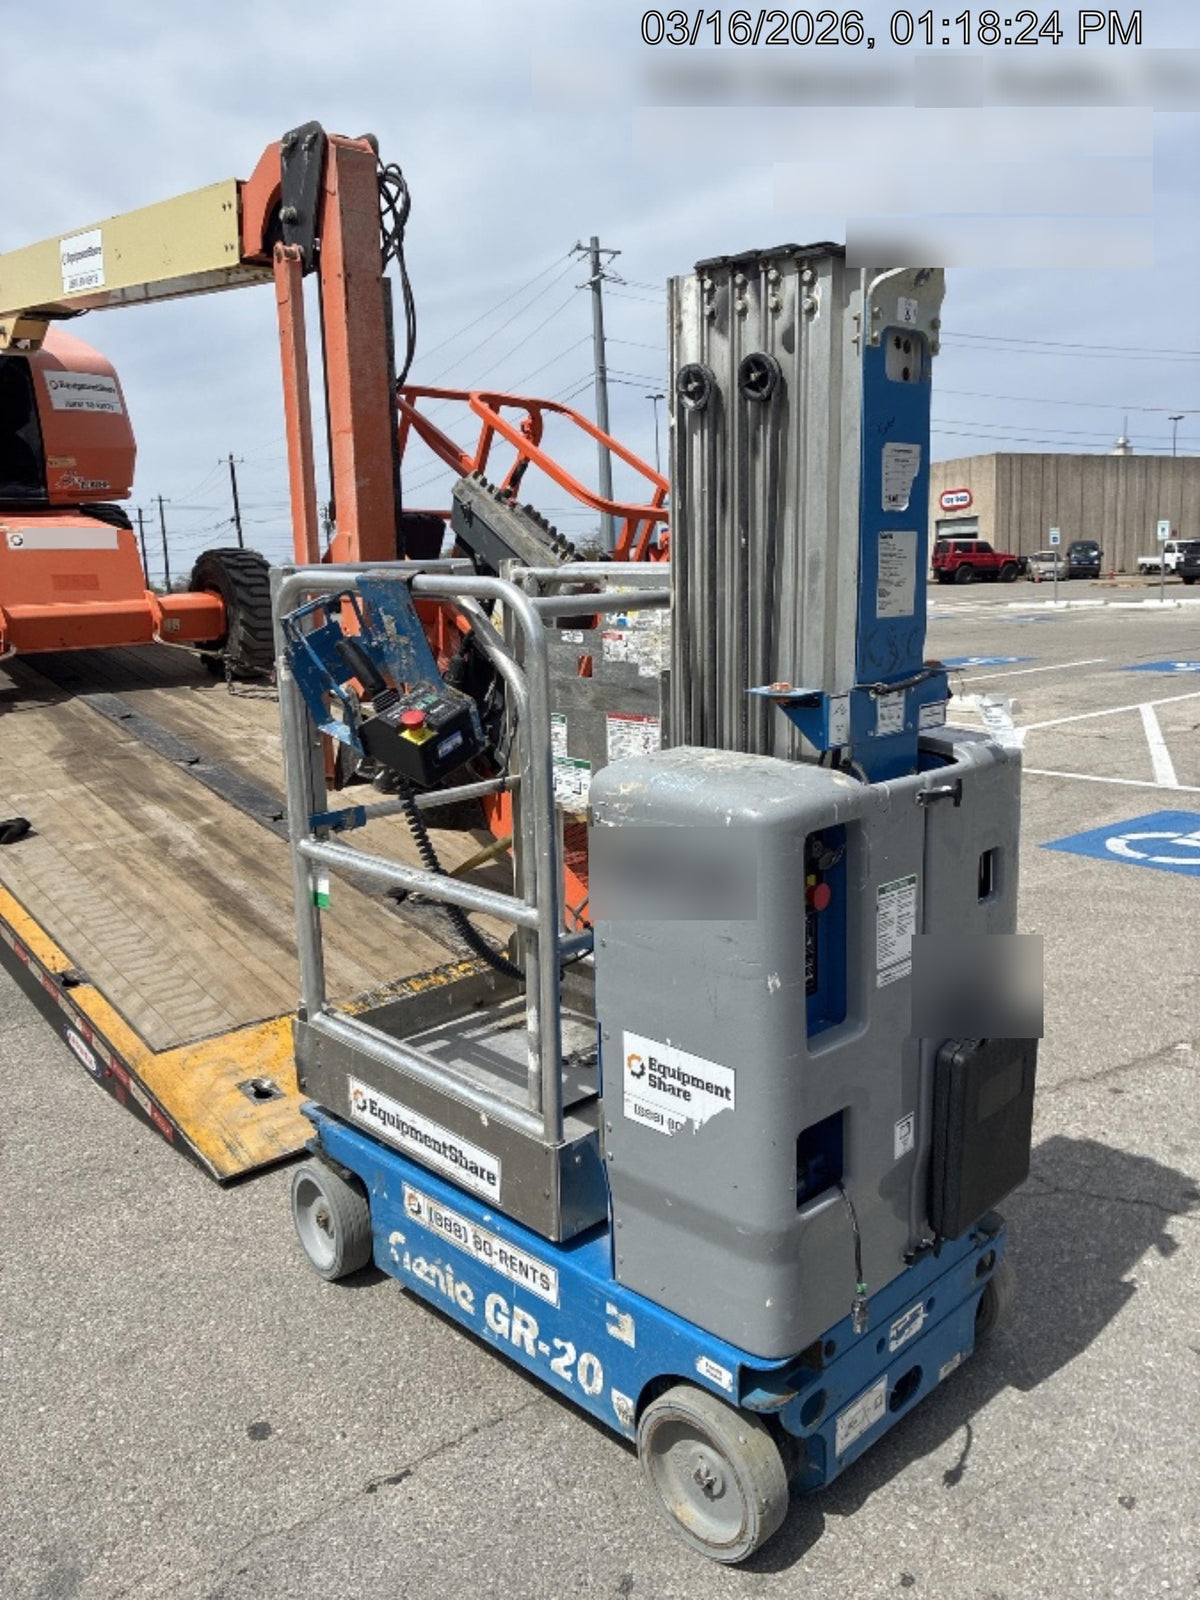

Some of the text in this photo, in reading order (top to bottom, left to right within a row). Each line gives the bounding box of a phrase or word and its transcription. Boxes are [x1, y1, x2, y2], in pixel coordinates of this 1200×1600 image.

[647, 1055, 732, 1101] Equipment
[647, 1072, 692, 1102] Share
[368, 1097, 497, 1187] EquipmentShare
[428, 1206, 551, 1292] (888) 80-RENTS
[484, 1291, 604, 1396] GR-20
